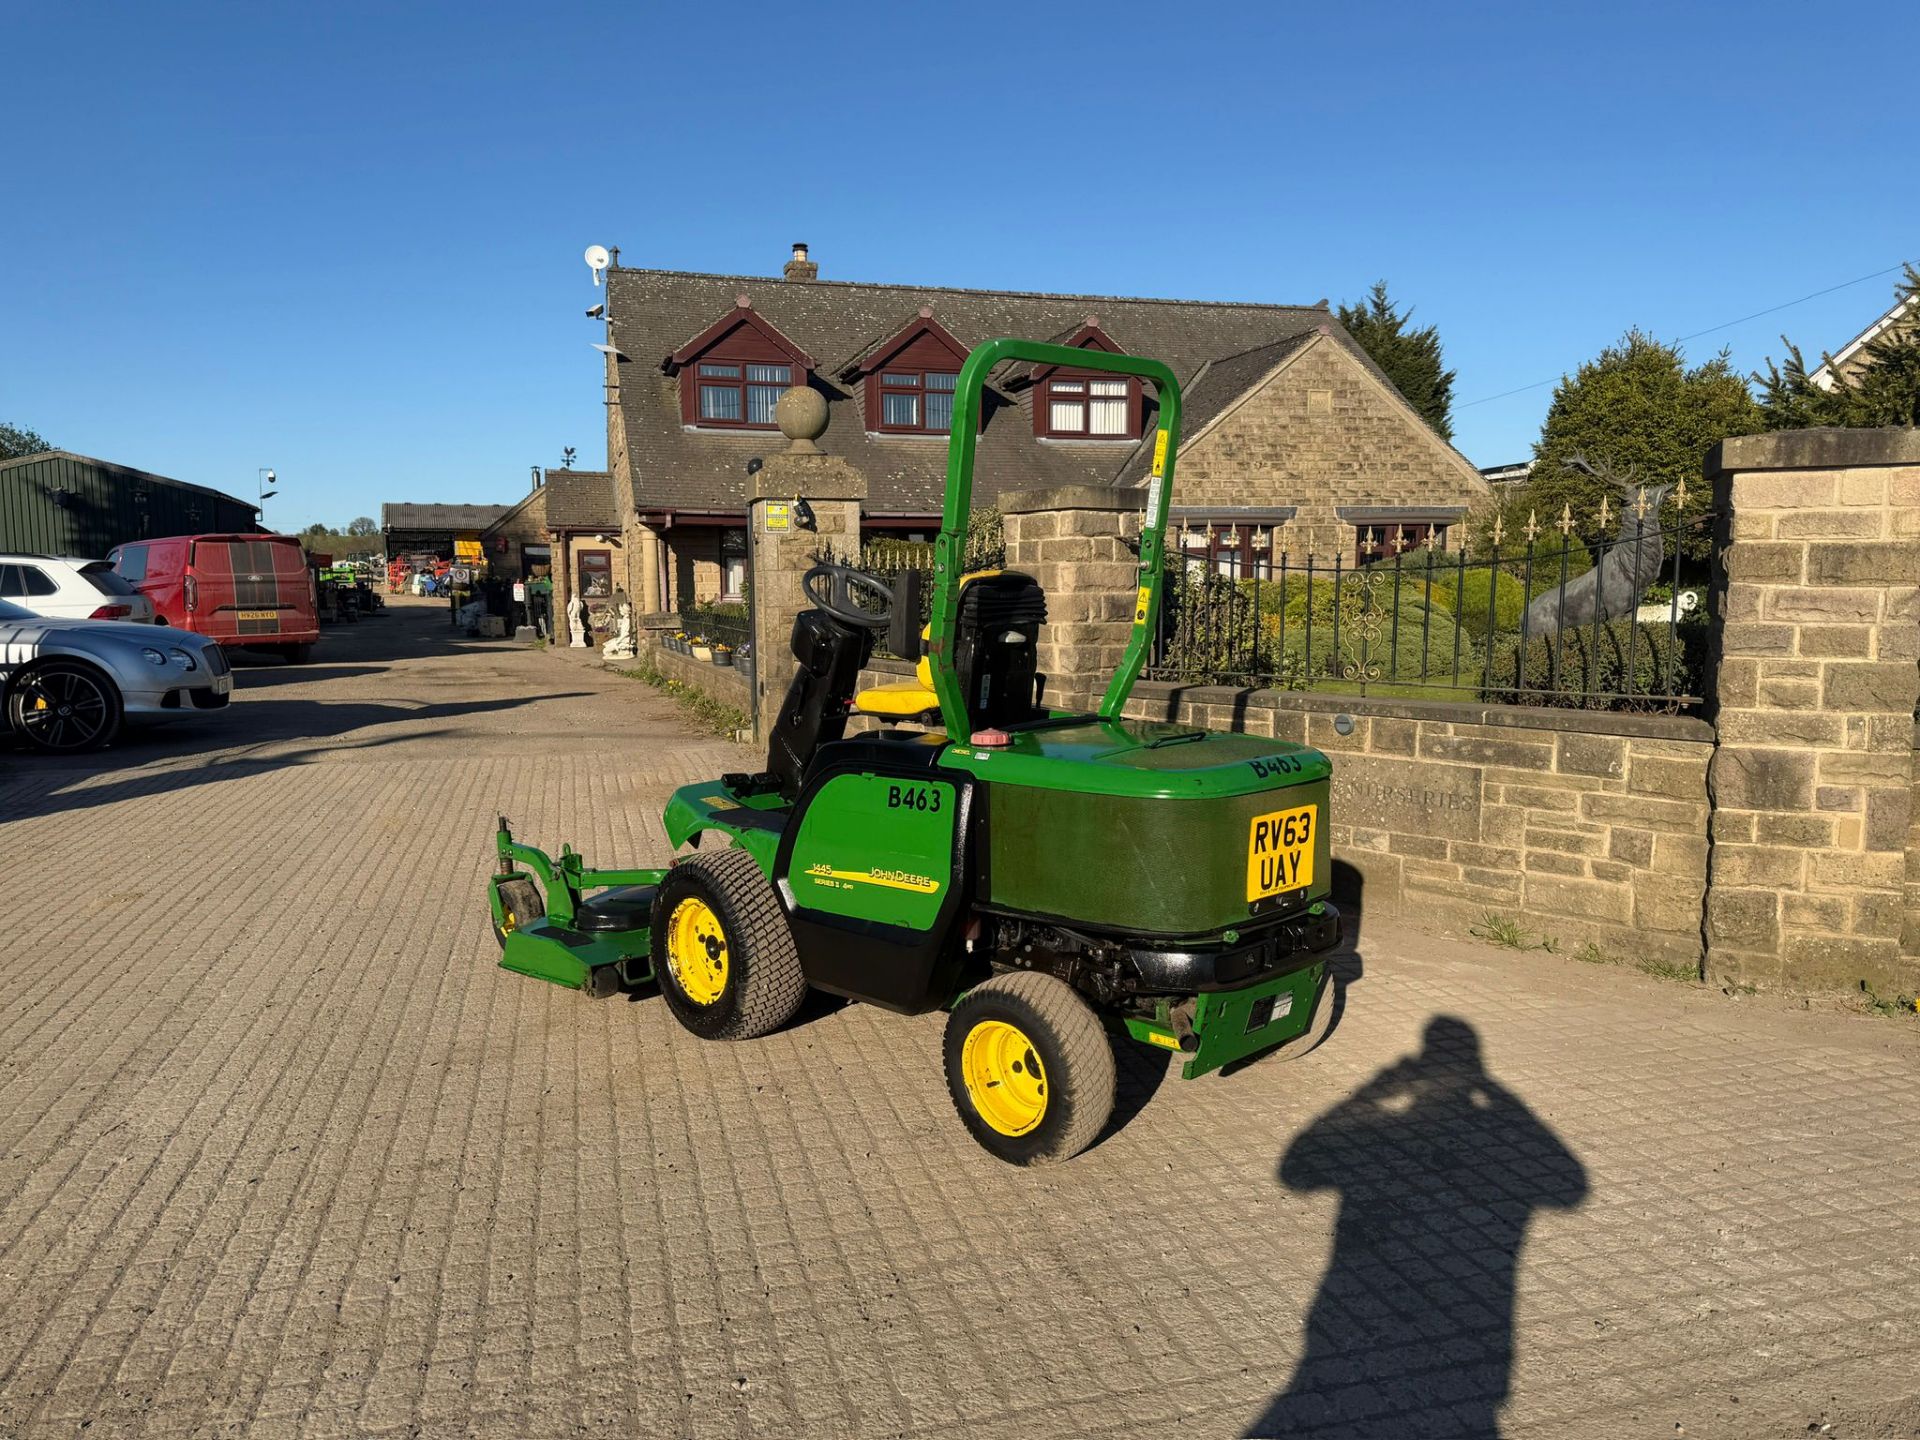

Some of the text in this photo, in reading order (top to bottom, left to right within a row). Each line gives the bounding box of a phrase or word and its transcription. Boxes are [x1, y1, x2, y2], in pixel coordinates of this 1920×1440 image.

[1249, 755, 1302, 778] B463
[888, 786, 940, 812] B463
[1350, 782, 1473, 812] NURSERIES
[1254, 812, 1311, 854] RV63
[812, 863, 832, 875] 1445
[868, 867, 931, 887] JOHN DEERE
[1260, 850, 1301, 890] UAY
[814, 878, 834, 887] SERIES
